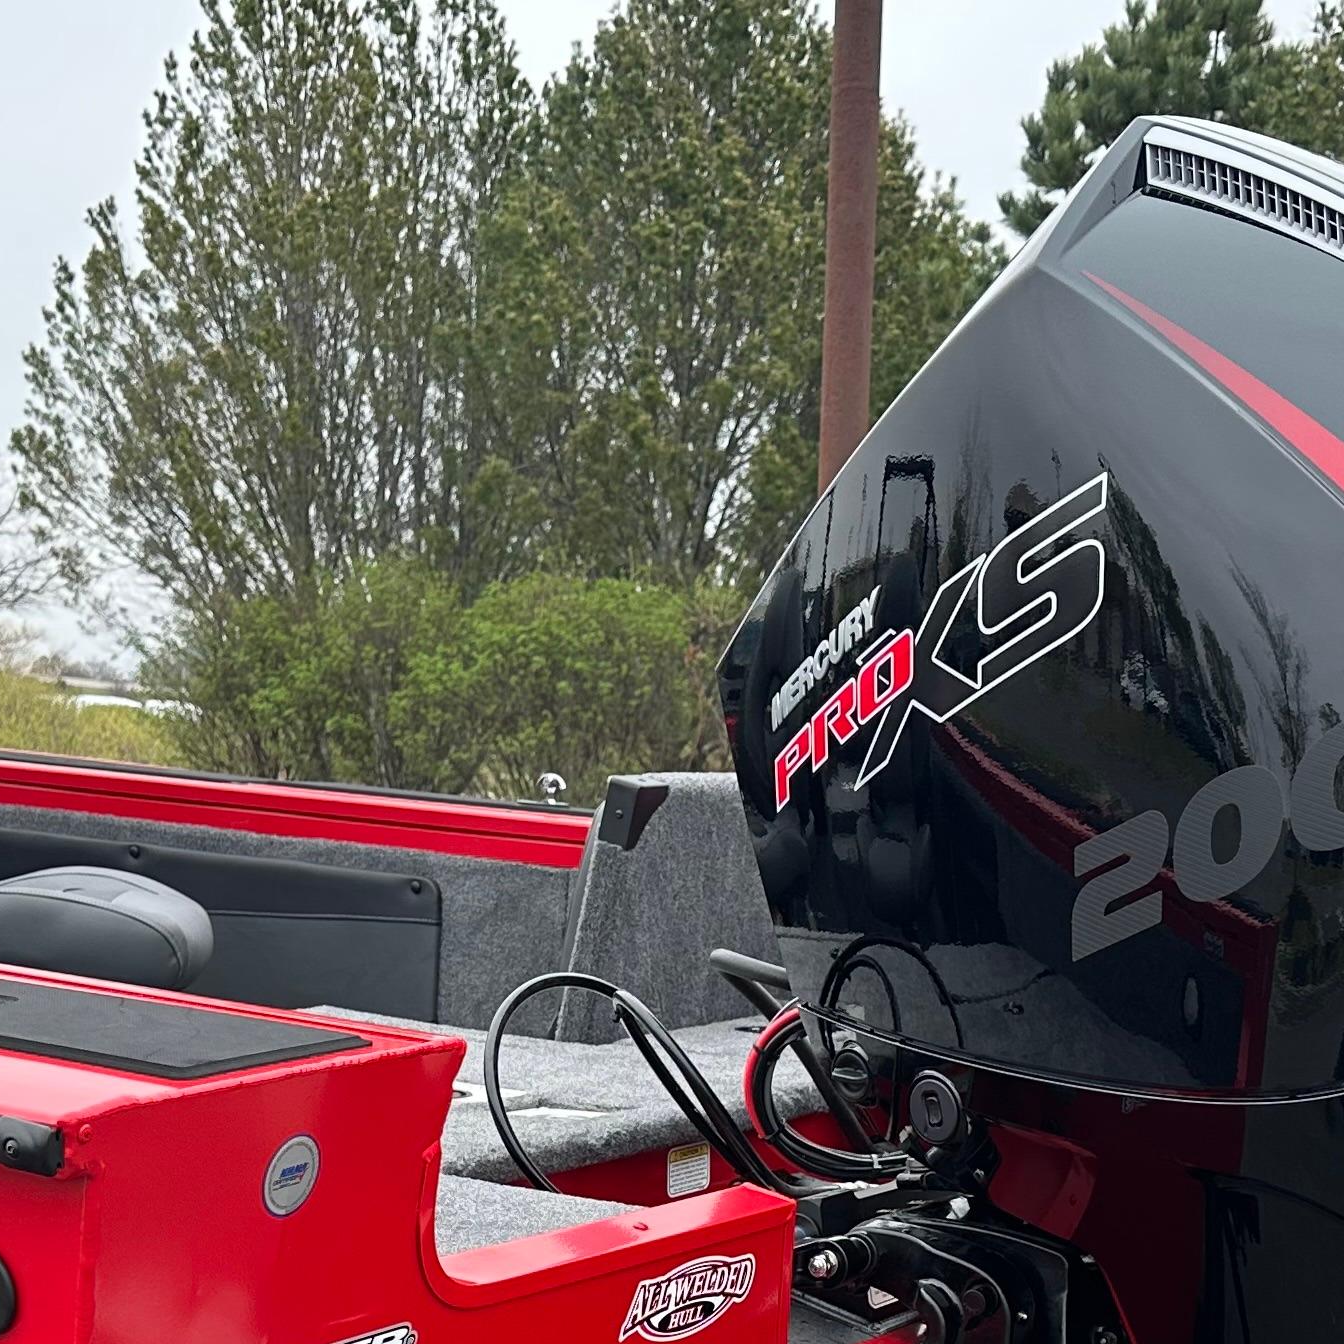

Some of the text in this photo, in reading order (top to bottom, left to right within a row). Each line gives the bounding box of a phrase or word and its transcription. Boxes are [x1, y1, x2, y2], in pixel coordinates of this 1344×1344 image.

[771, 584, 881, 733] MERCURY
[775, 472, 1108, 814] PRO XS
[624, 1260, 752, 1329] ALL WELDED
[668, 1304, 705, 1330] HULL
